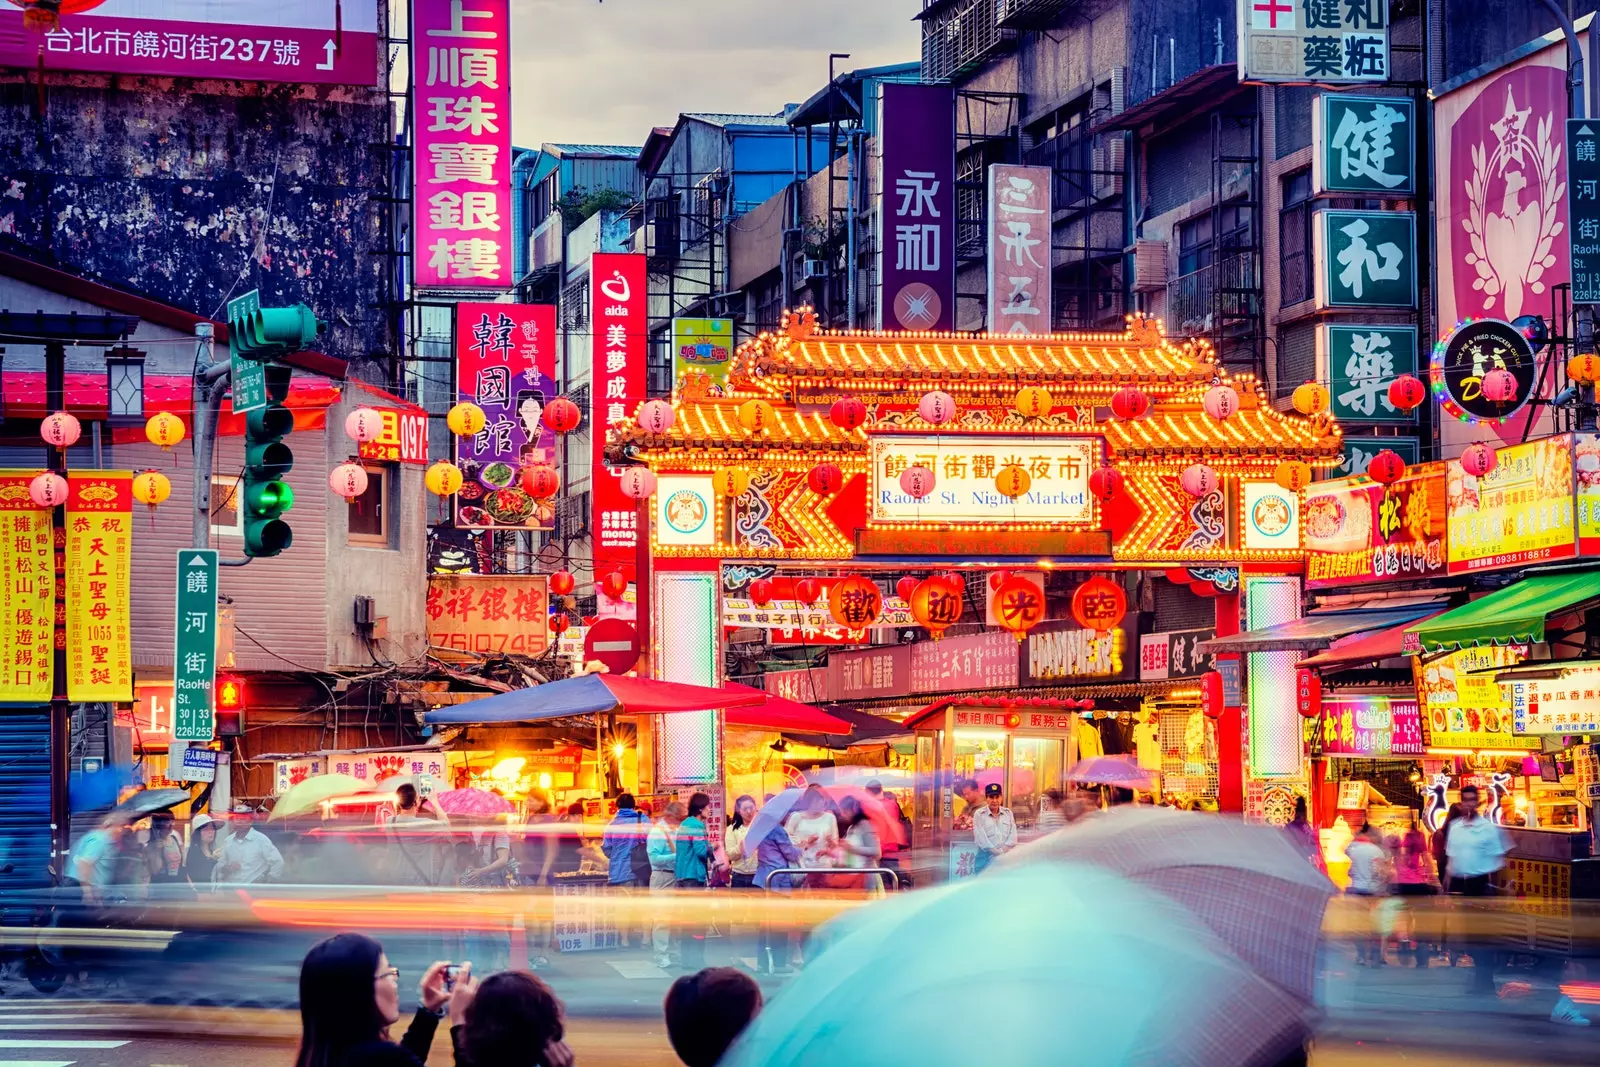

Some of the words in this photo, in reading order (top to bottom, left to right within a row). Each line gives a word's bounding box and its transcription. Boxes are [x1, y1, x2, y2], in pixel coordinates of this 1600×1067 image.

[44, 27, 300, 66] 台北市饒河街237號
[426, 0, 501, 281] 上順珠寶銀樓
[1575, 139, 1599, 239] 饒河街
[895, 169, 941, 271] 永和
[1573, 259, 1586, 269] St.
[1575, 273, 1586, 282] 30
[1574, 290, 1589, 300] 226
[605, 304, 629, 317] aida
[520, 320, 542, 386] 한국관
[1474, 333, 1489, 342] FRIED
[1491, 334, 1511, 348] CHICKEN
[1510, 348, 1522, 368] CUTLET
[469, 313, 517, 457] 韓國館
[884, 454, 1082, 480] 饒河街觀光夜市
[940, 490, 961, 505] St.
[972, 491, 1017, 508] Night
[1027, 490, 1085, 505] Market
[601, 530, 638, 541] money
[1503, 517, 1514, 536] VS
[842, 589, 877, 622] 歡
[928, 591, 957, 623] 迎
[1003, 592, 1040, 621] 光
[1082, 593, 1117, 619] 臨
[185, 570, 208, 674] 饒河街
[178, 678, 211, 689] RaoHe
[178, 693, 191, 704] St.
[179, 709, 190, 719] 30
[198, 709, 210, 719] 33
[957, 712, 1005, 726] 媽祖廟口
[1030, 714, 1069, 728] 服務台
[176, 726, 192, 737] 226
[196, 726, 212, 737] 255
